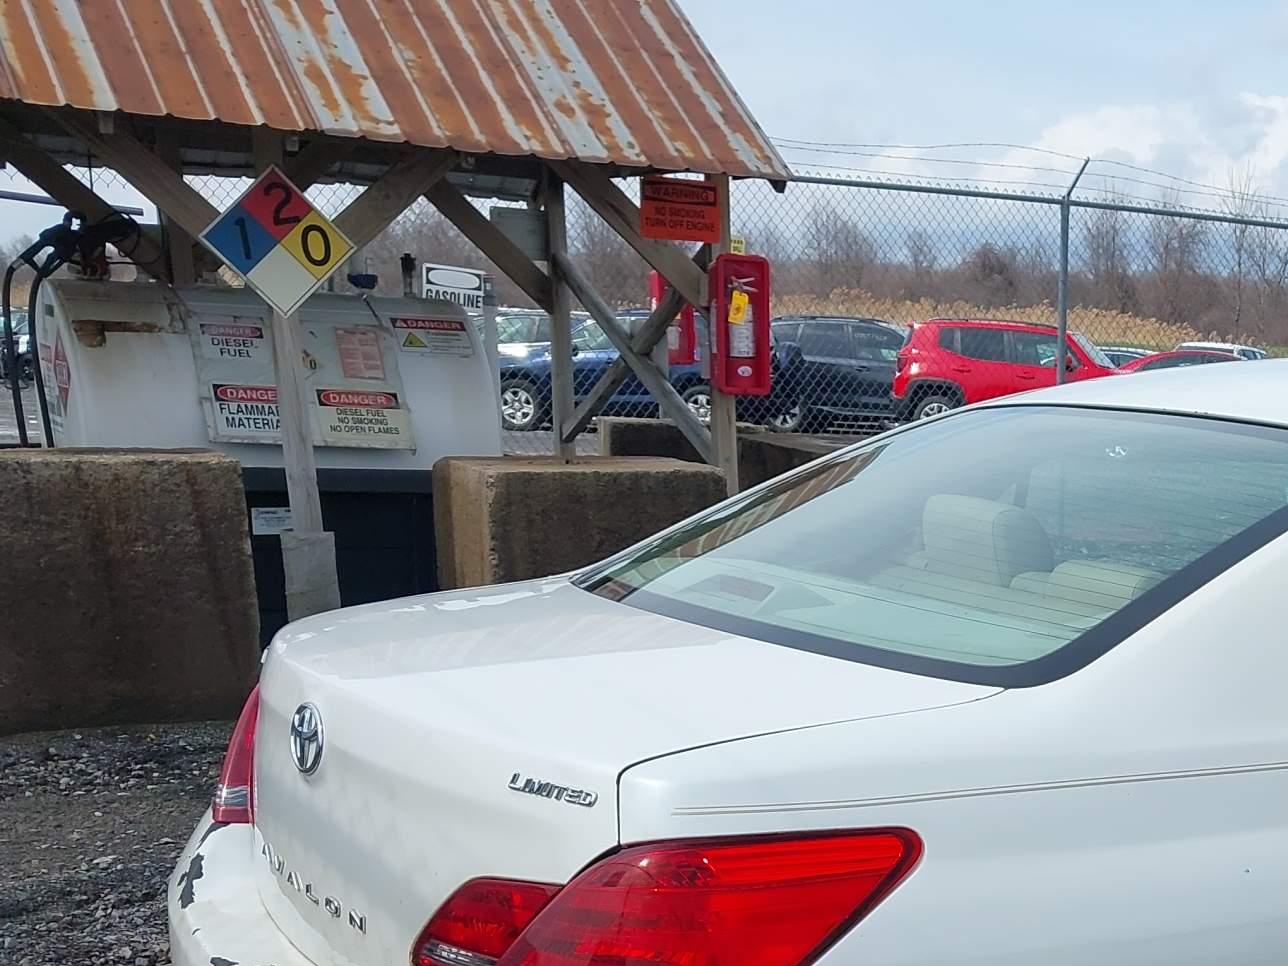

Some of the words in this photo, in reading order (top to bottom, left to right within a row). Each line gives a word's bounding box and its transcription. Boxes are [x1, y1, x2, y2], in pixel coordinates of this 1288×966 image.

[648, 185, 709, 200] WARNING
[263, 181, 301, 226] 2
[234, 217, 252, 260] 1
[301, 224, 331, 267] 0
[425, 288, 482, 308] GASOLINE
[220, 348, 252, 358] FUEL
[329, 393, 386, 405] DANGER
[336, 408, 362, 416] DIESEL
[351, 417, 388, 426] SMOKING
[330, 425, 342, 433] NO
[344, 425, 366, 433] OPEN
[368, 427, 400, 435] FLAMES
[508, 772, 598, 807] LIMITED
[262, 842, 366, 934] AVALON
